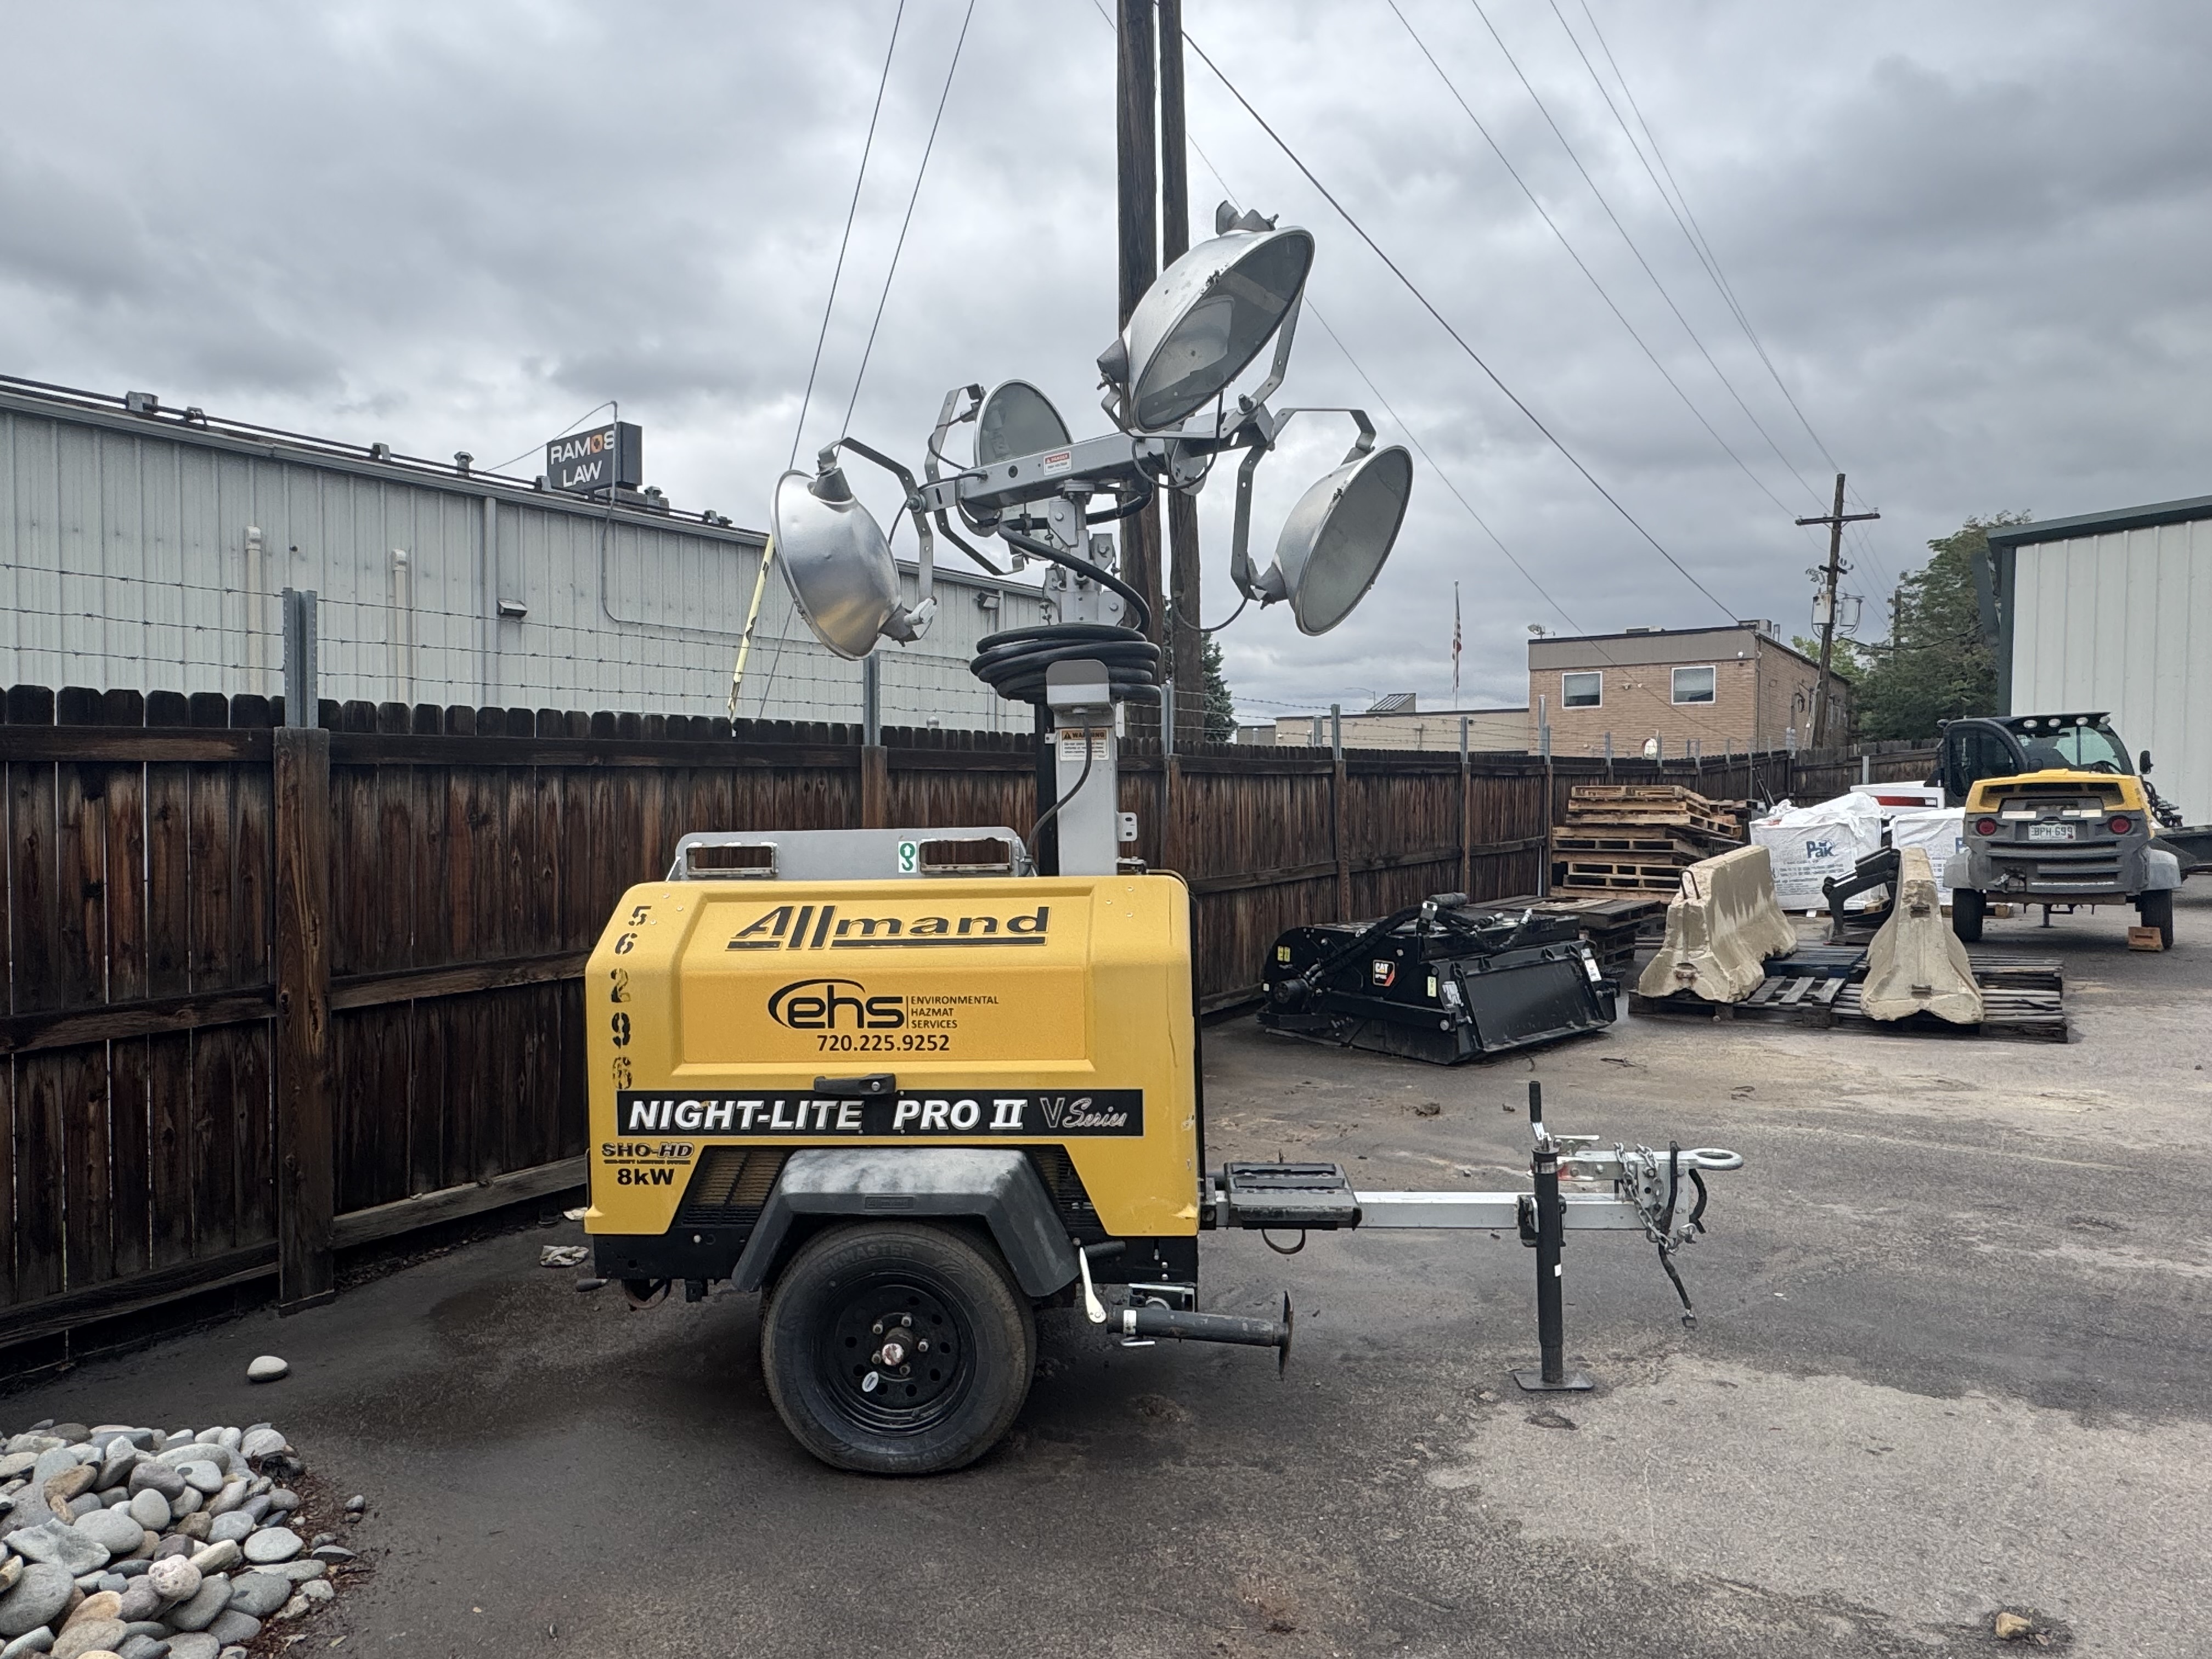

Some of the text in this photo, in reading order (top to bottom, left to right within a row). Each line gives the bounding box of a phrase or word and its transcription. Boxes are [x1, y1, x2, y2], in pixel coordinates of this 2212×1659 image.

[551, 431, 614, 465] RAMOS
[563, 460, 602, 487] LAW
[725, 905, 1050, 950] Allmand
[1375, 962, 1389, 974] CAT
[787, 984, 906, 1029] ehs
[911, 996, 999, 1005] ENVIRONMENTAL
[911, 1008, 955, 1017] HAZMAT
[911, 1020, 958, 1029] SERVICES
[817, 1035, 950, 1051] 720.225.9252
[628, 1097, 1128, 1131] NIGHT-LITE PRO II V Series
[601, 1142, 694, 1158] SHO-HD
[617, 1168, 675, 1185] 8kW
